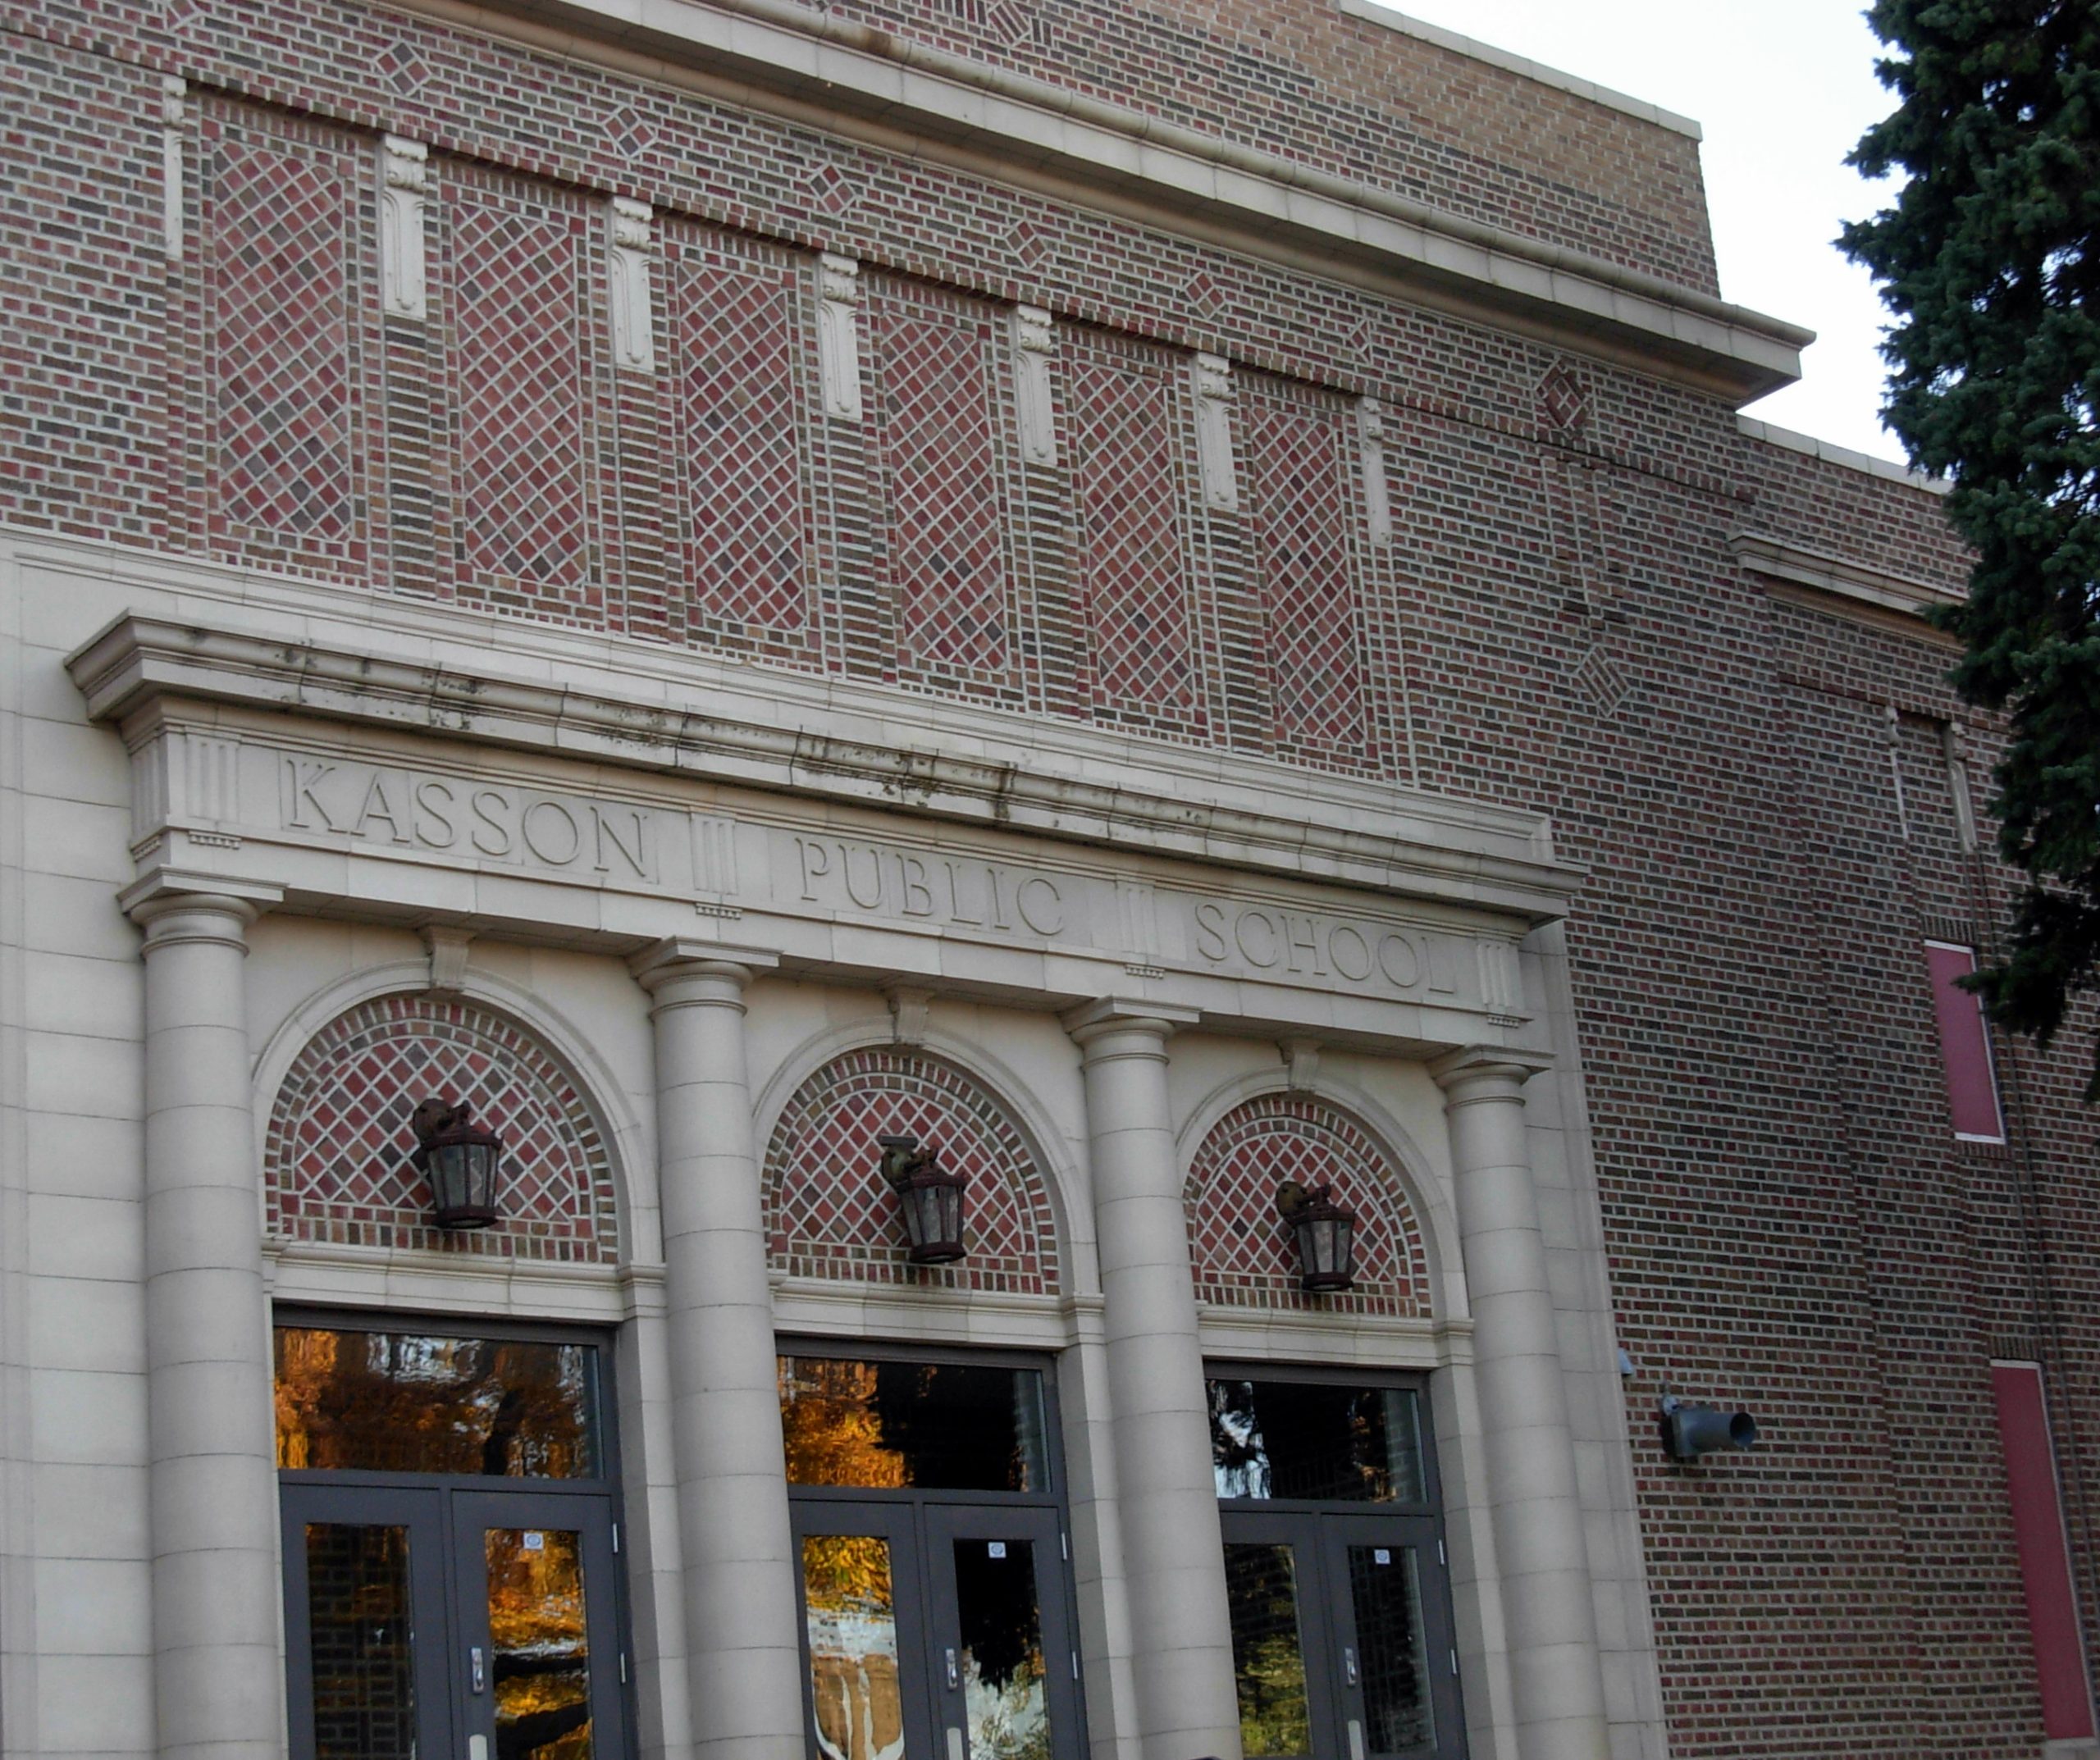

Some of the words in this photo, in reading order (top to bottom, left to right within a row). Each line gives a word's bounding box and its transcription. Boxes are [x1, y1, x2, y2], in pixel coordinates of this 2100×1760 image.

[287, 758, 647, 878] KASSON
[794, 836, 1064, 936] PUBLIC
[1194, 903, 1454, 994] SCHOOL
